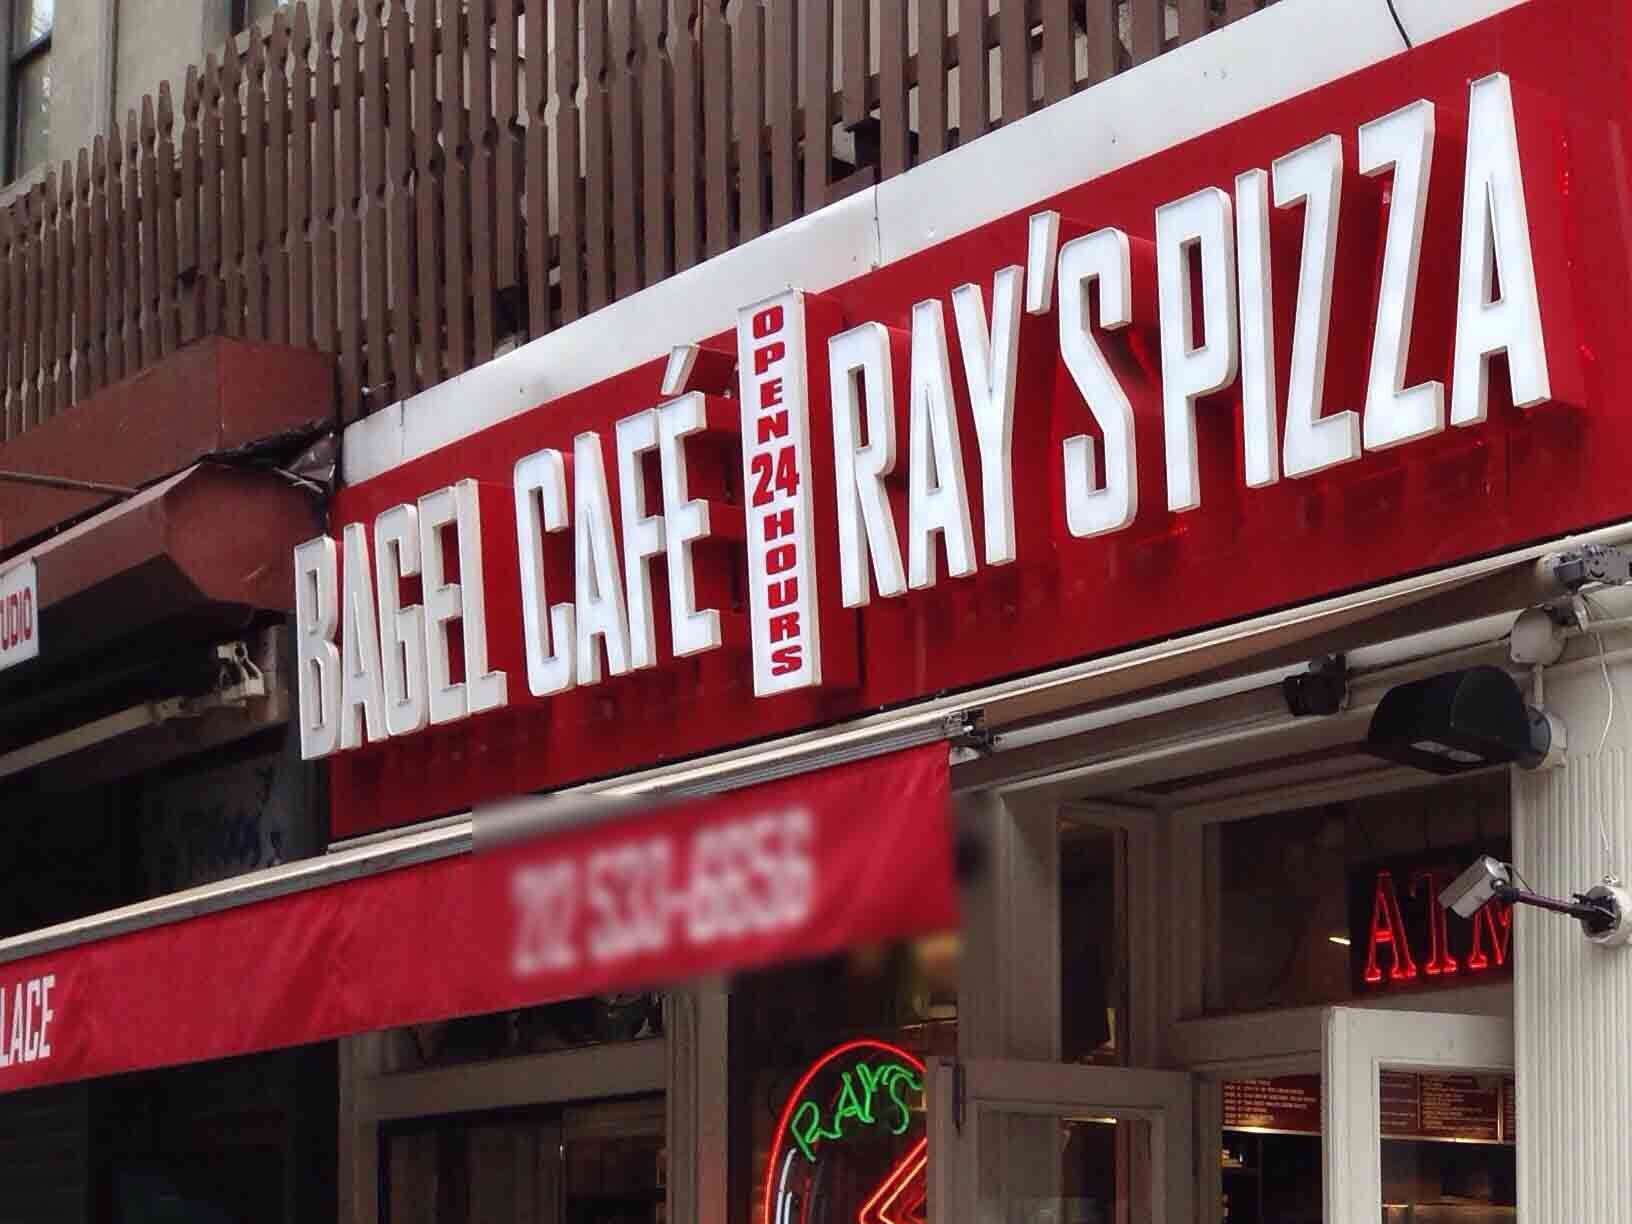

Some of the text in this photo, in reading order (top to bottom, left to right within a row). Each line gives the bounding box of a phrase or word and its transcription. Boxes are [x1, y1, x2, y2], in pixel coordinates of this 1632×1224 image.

[751, 304, 802, 678] OPEN 24 HOURS
[828, 71, 1552, 609] RAY'S PIZZA
[294, 344, 723, 761] BAGEL CAFÉ
